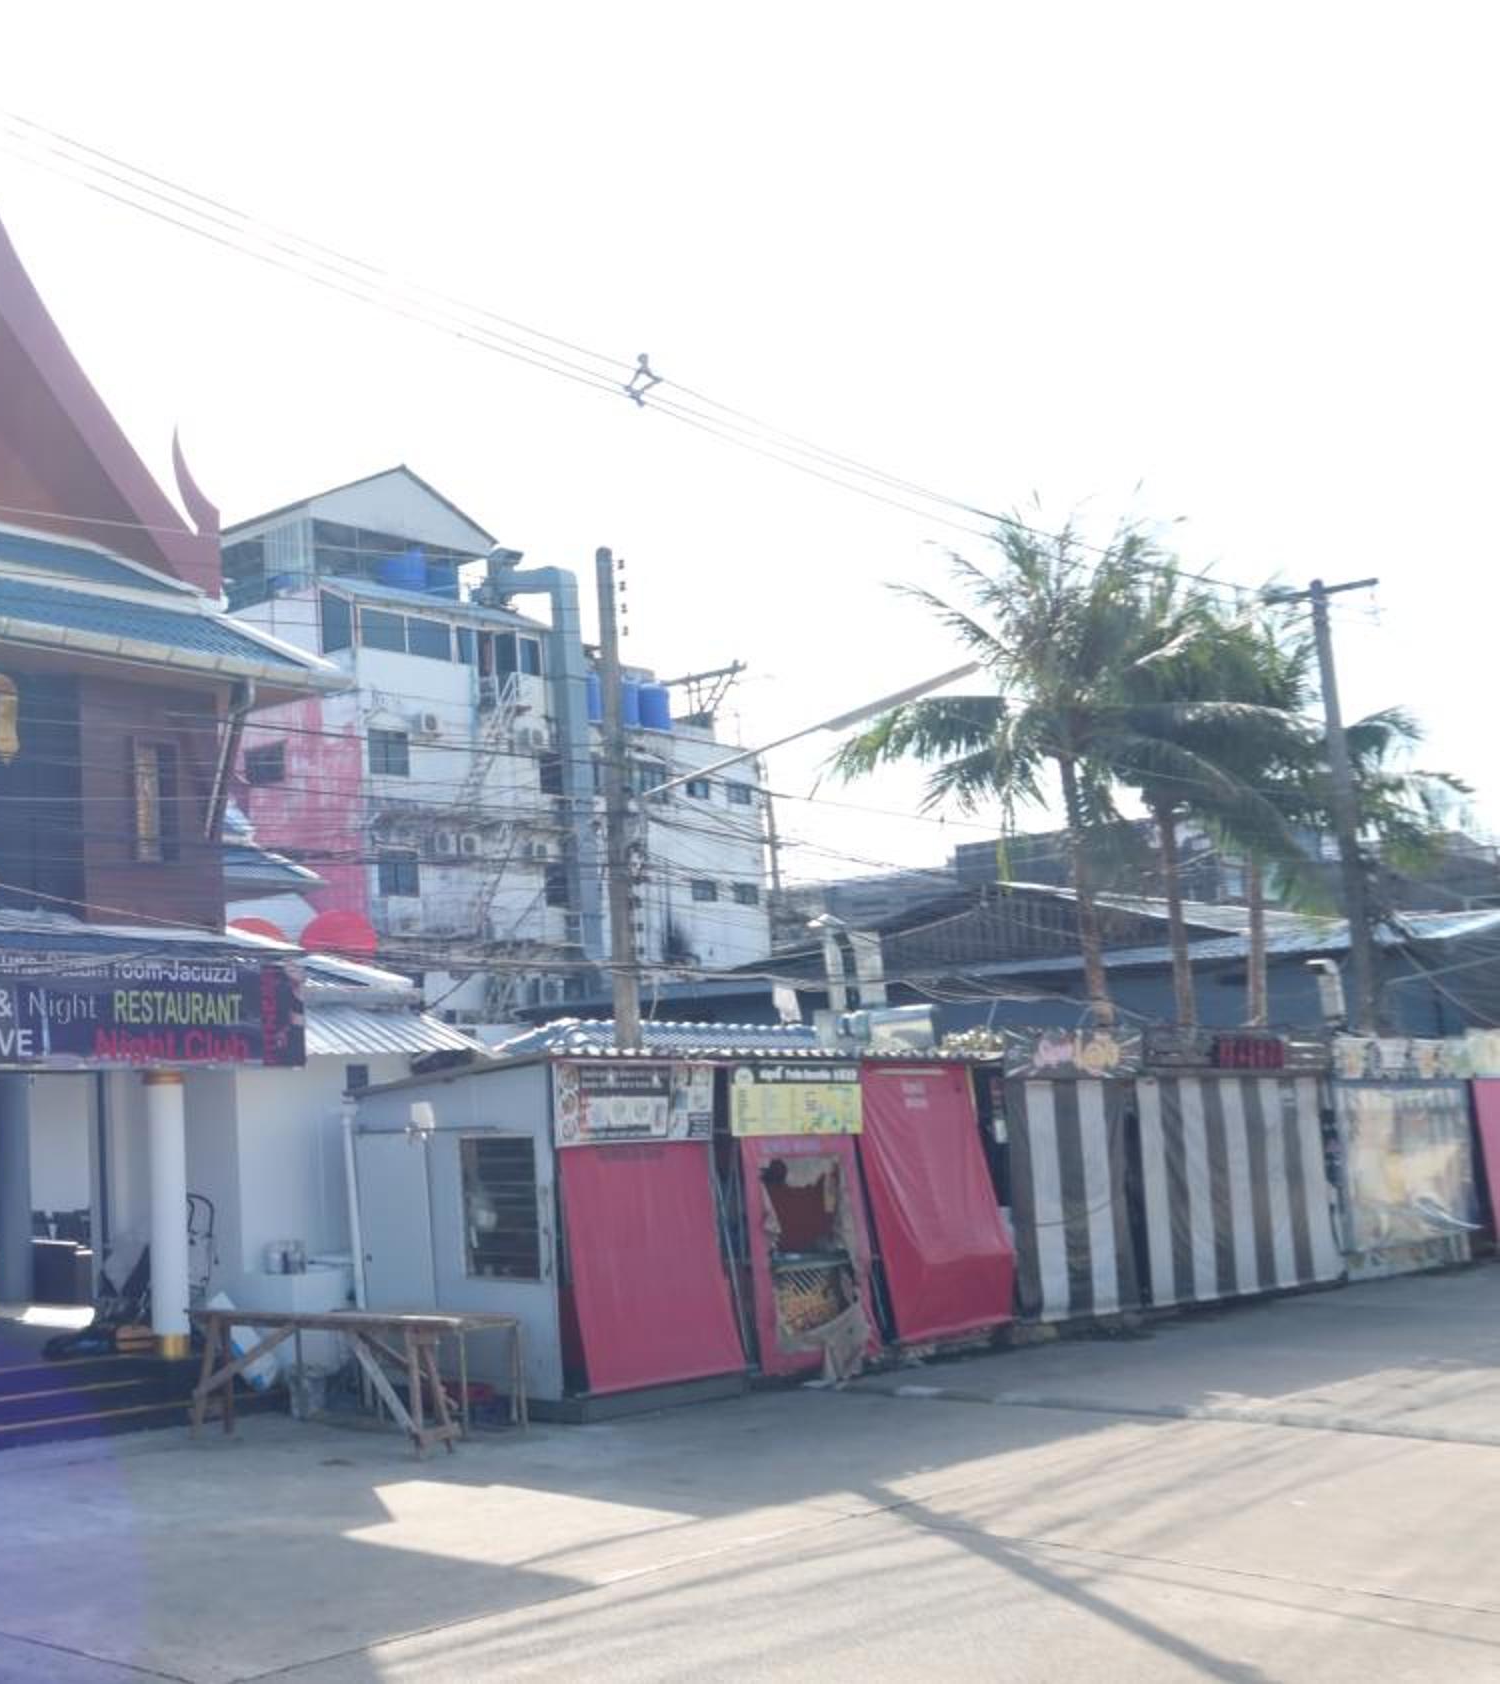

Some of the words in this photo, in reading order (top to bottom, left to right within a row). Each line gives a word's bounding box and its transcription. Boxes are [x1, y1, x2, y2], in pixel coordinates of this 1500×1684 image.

[29, 990, 97, 1024] Night
[113, 989, 243, 1024] RESTAURANT
[94, 1024, 178, 1066] Night
[185, 1029, 248, 1063] Club
